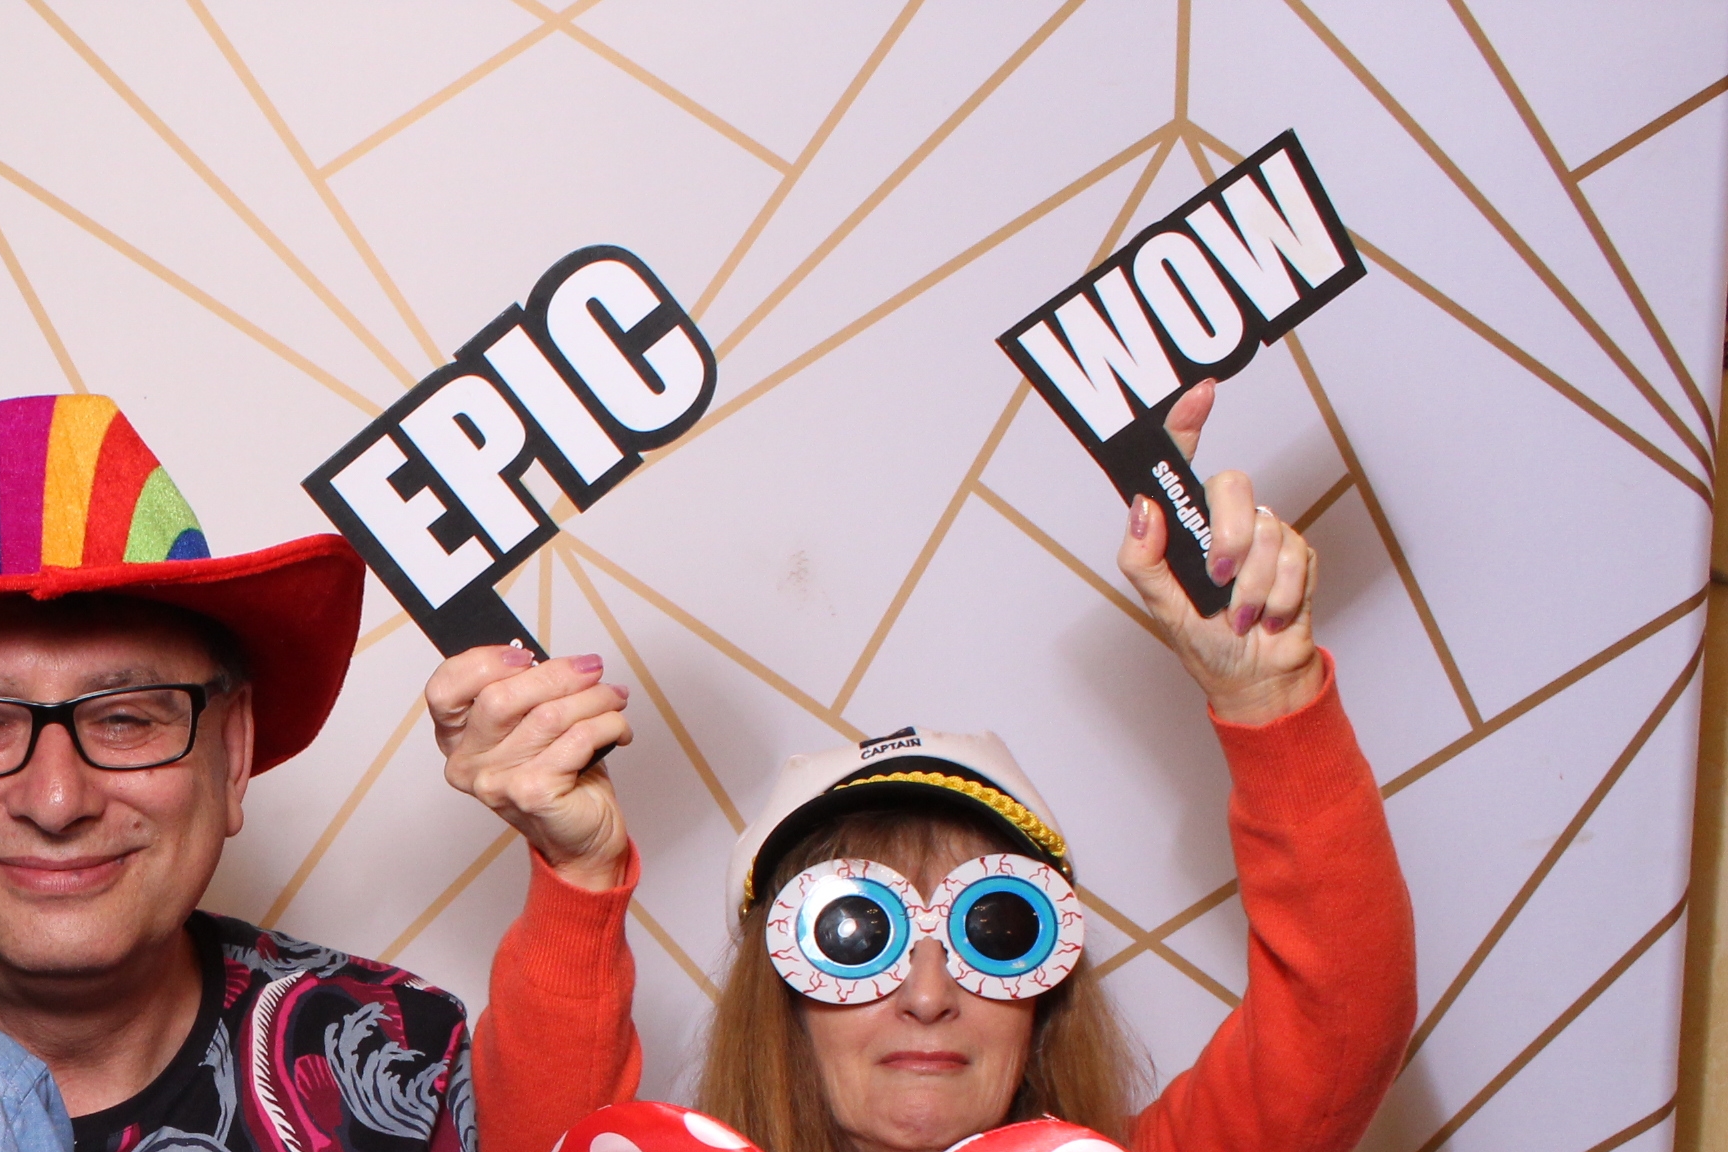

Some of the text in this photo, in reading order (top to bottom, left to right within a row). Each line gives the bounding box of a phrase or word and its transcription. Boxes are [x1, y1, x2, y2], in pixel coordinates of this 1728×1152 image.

[1019, 148, 1347, 442] WOW
[330, 259, 705, 608] EPIC
[1152, 461, 1212, 559] ordProps
[860, 738, 922, 760] CAPTAIN
